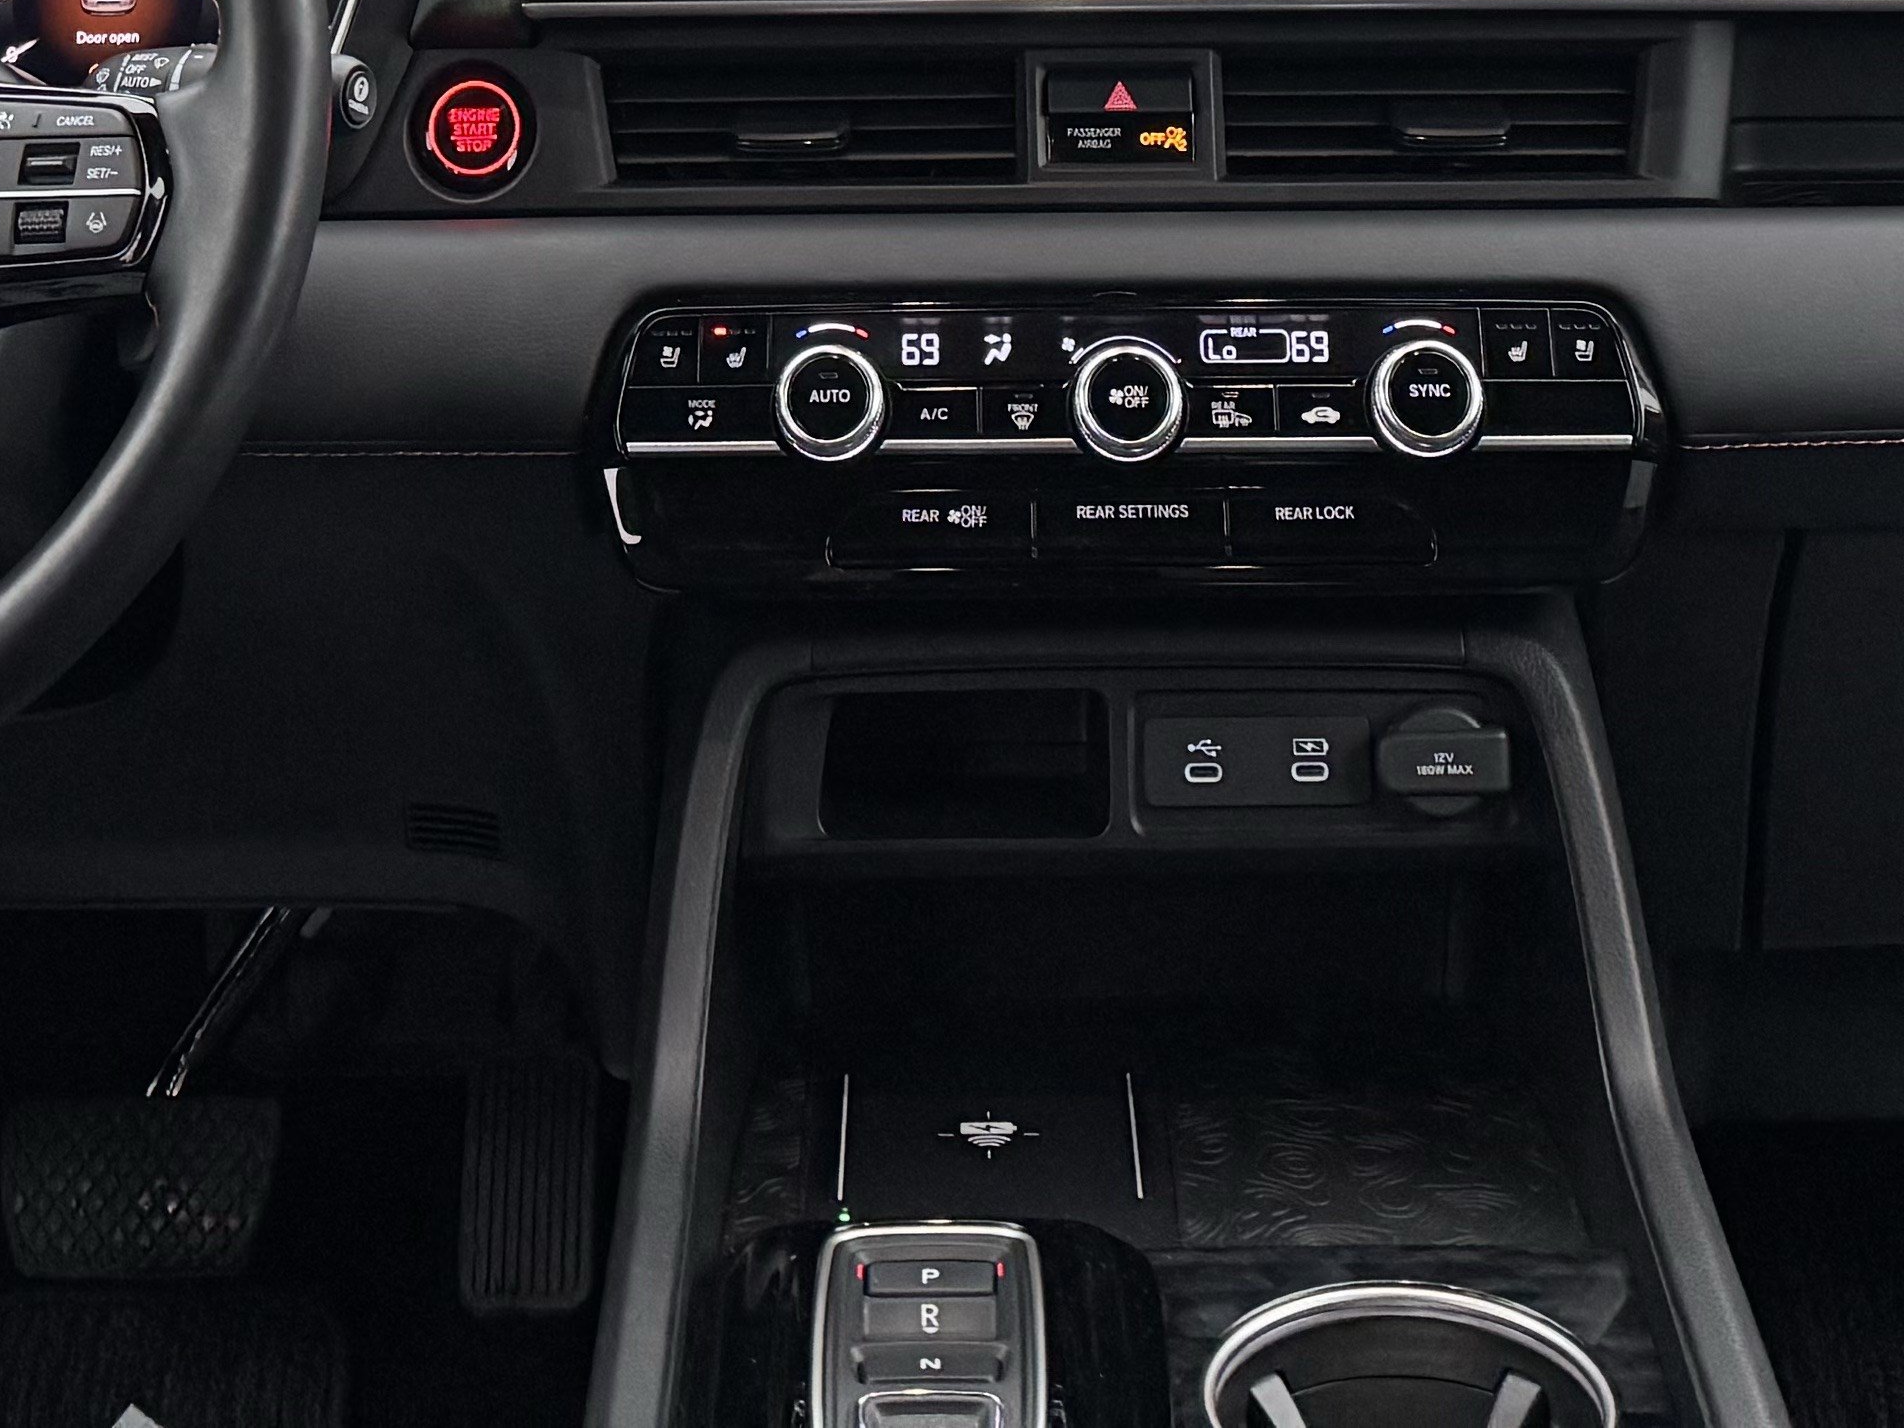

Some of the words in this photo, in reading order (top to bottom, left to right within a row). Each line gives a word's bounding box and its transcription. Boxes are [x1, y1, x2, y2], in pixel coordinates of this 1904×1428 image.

[76, 30, 107, 45] Door
[108, 31, 140, 46] open
[125, 64, 146, 75] OFF
[121, 76, 150, 88] AUTO
[56, 114, 95, 127] CANCEL
[449, 107, 500, 123] ENGINE
[453, 122, 497, 136] START
[1066, 127, 1122, 138] PASSENGER
[1139, 131, 1166, 146] OFF
[456, 140, 493, 153] STOP
[1230, 327, 1257, 338] REAR
[901, 332, 940, 367] 69
[1290, 330, 1330, 363] 69
[809, 389, 851, 404] AUTO
[1124, 385, 1149, 397] ON/
[1408, 382, 1452, 399] SYNC
[688, 398, 717, 409] MODE
[1124, 397, 1149, 408] OFF
[1211, 401, 1236, 410] REAR
[919, 406, 949, 421] A/C
[901, 508, 939, 523] REAR
[1076, 504, 1115, 519] REAR
[1118, 503, 1189, 520] SETTINGS
[1275, 505, 1313, 521] REAR
[1315, 504, 1355, 520] LOCK
[961, 516, 988, 528] OFF
[1433, 752, 1454, 764] 12V
[1447, 764, 1474, 776] MAX
[920, 1267, 941, 1285] P
[920, 1303, 940, 1326] R
[919, 1358, 942, 1370] N
